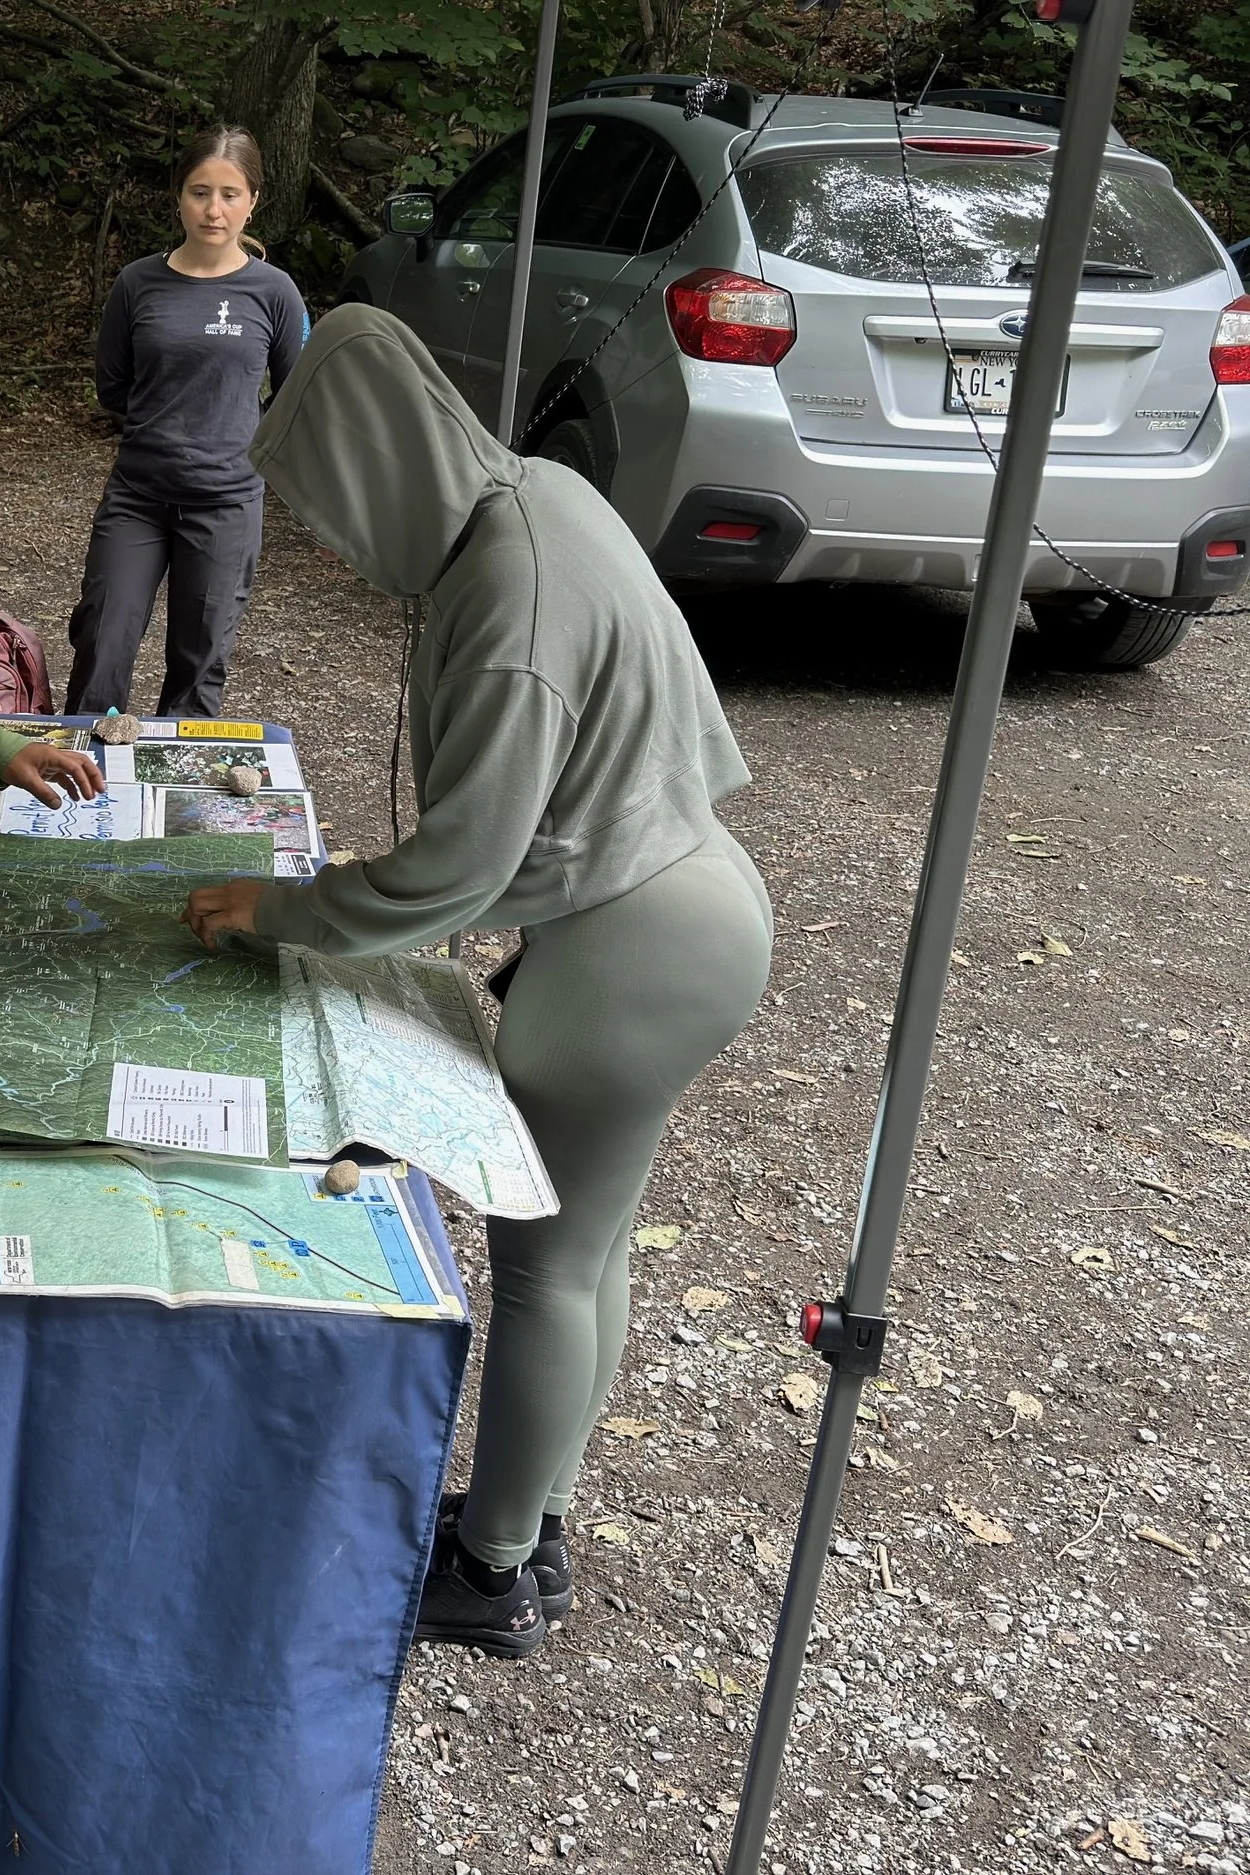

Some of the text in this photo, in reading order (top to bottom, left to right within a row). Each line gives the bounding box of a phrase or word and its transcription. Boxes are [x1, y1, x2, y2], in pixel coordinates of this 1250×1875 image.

[980, 357, 1005, 366] NEW
[791, 393, 868, 407] SUBARU
[1135, 409, 1201, 419] CROSSTREK
[7, 811, 55, 837] Permit
